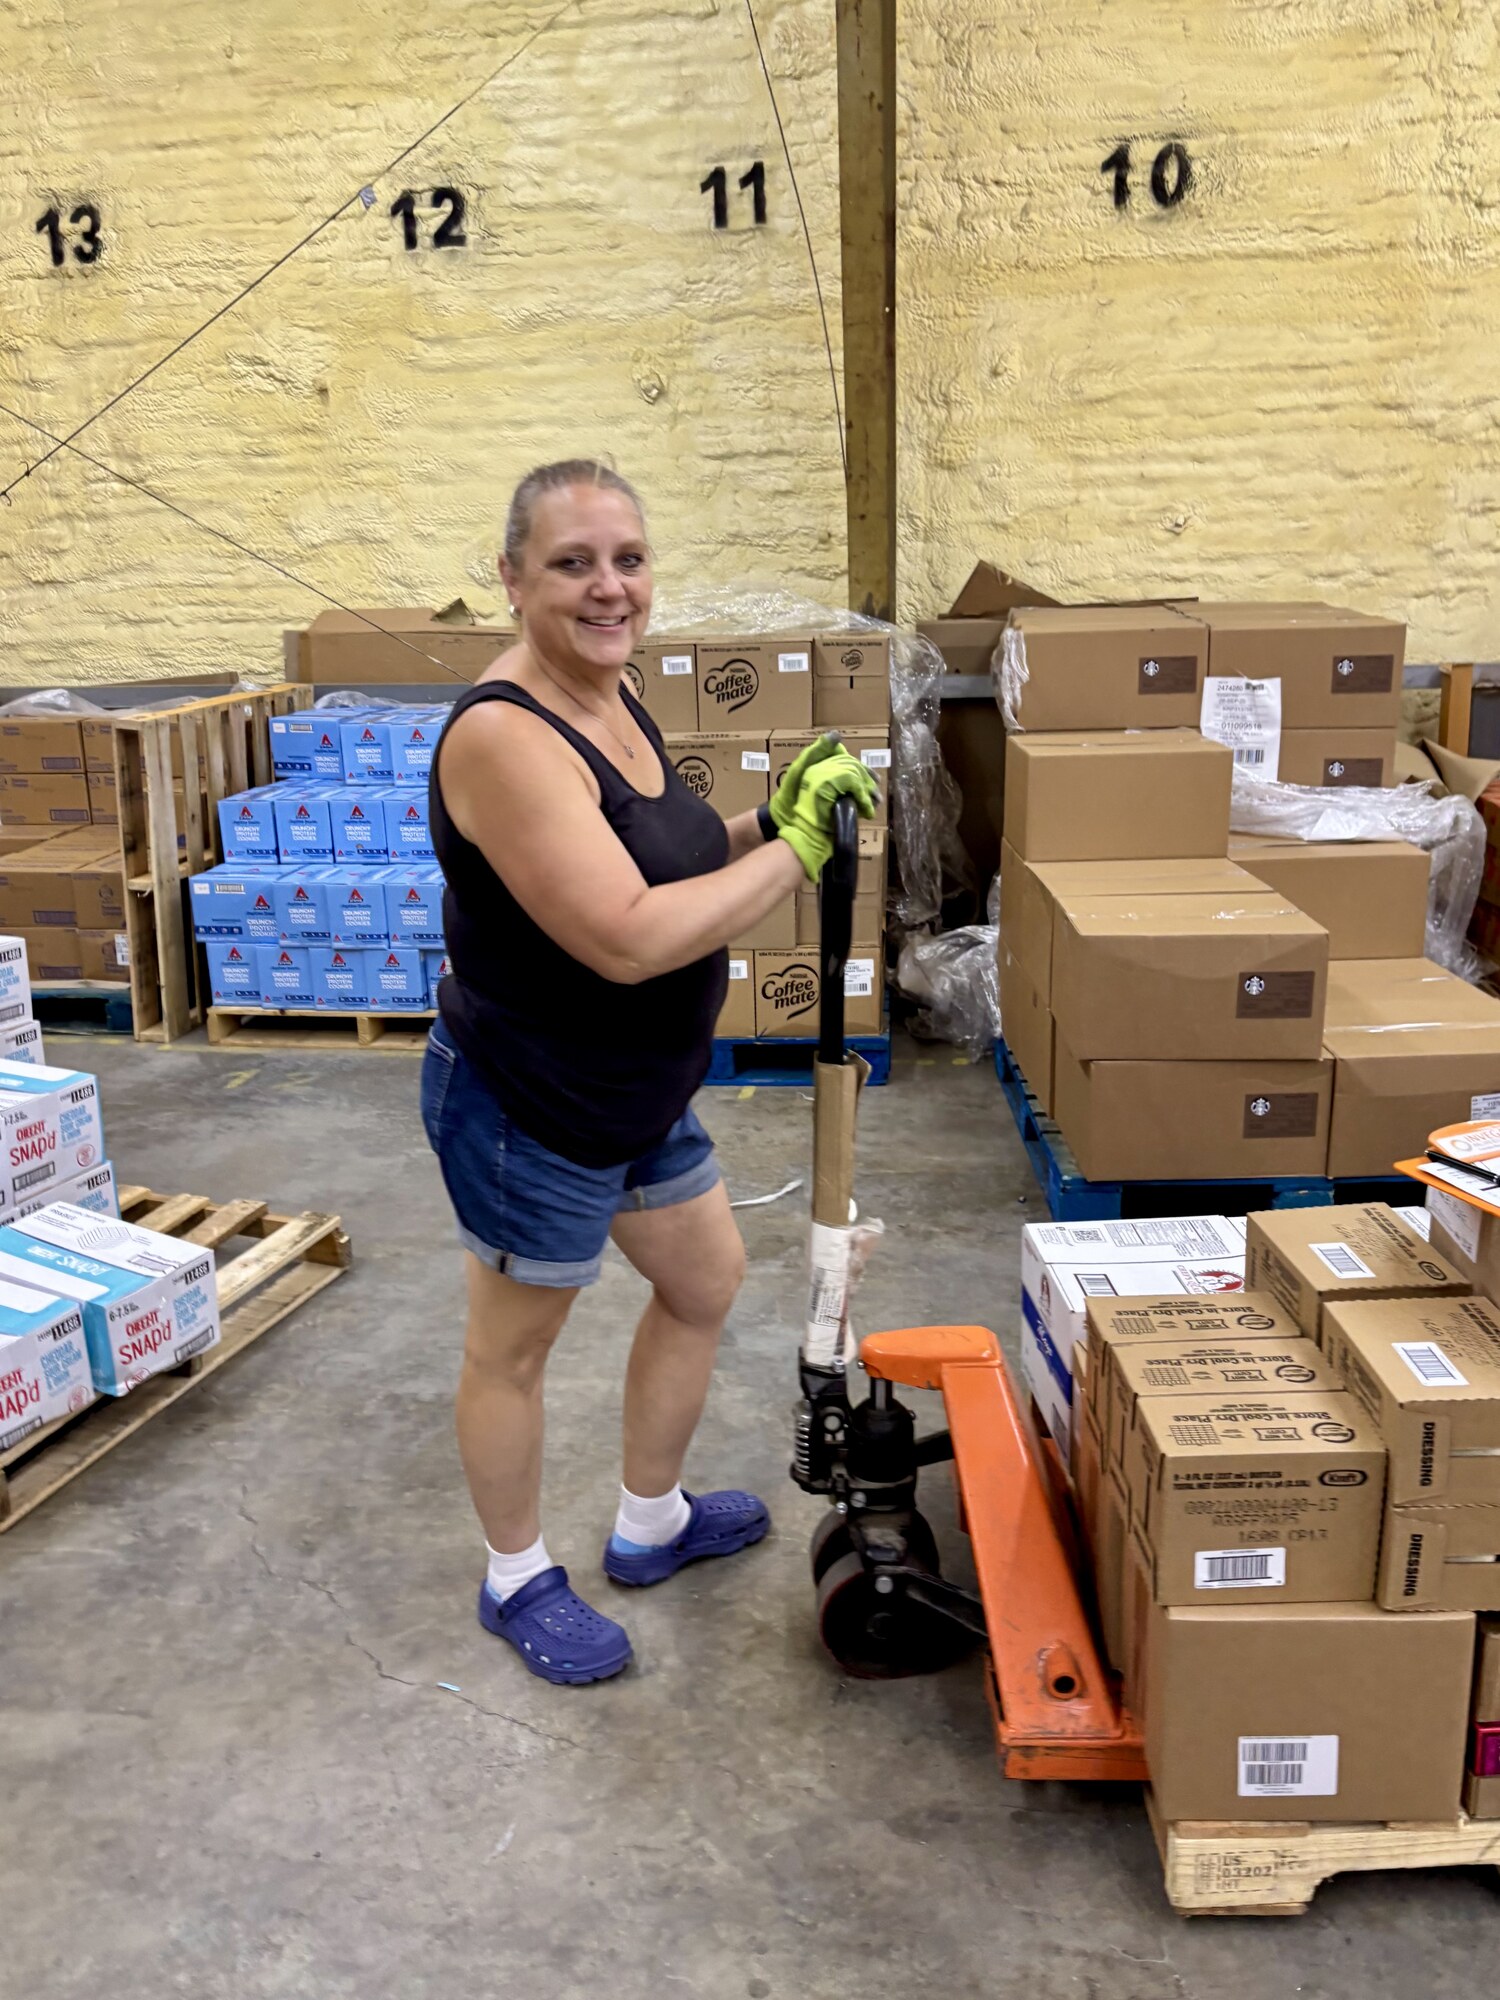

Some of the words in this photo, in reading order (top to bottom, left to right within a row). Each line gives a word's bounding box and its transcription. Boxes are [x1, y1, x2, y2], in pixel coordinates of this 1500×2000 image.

[1101, 142, 1192, 210] 10
[700, 160, 768, 229] 11
[390, 186, 468, 252] 12
[36, 203, 102, 267] 13
[704, 674, 752, 695] Coffee
[716, 684, 754, 704] mate
[761, 980, 814, 1000] Coffee
[775, 990, 815, 1010] mate
[1172, 1415, 1211, 1424] Place
[1242, 1414, 1272, 1422] Cool
[1294, 1412, 1332, 1420] Store
[1419, 1421, 1436, 1487] DRESSING
[1403, 1533, 1424, 1597] DRESSING
